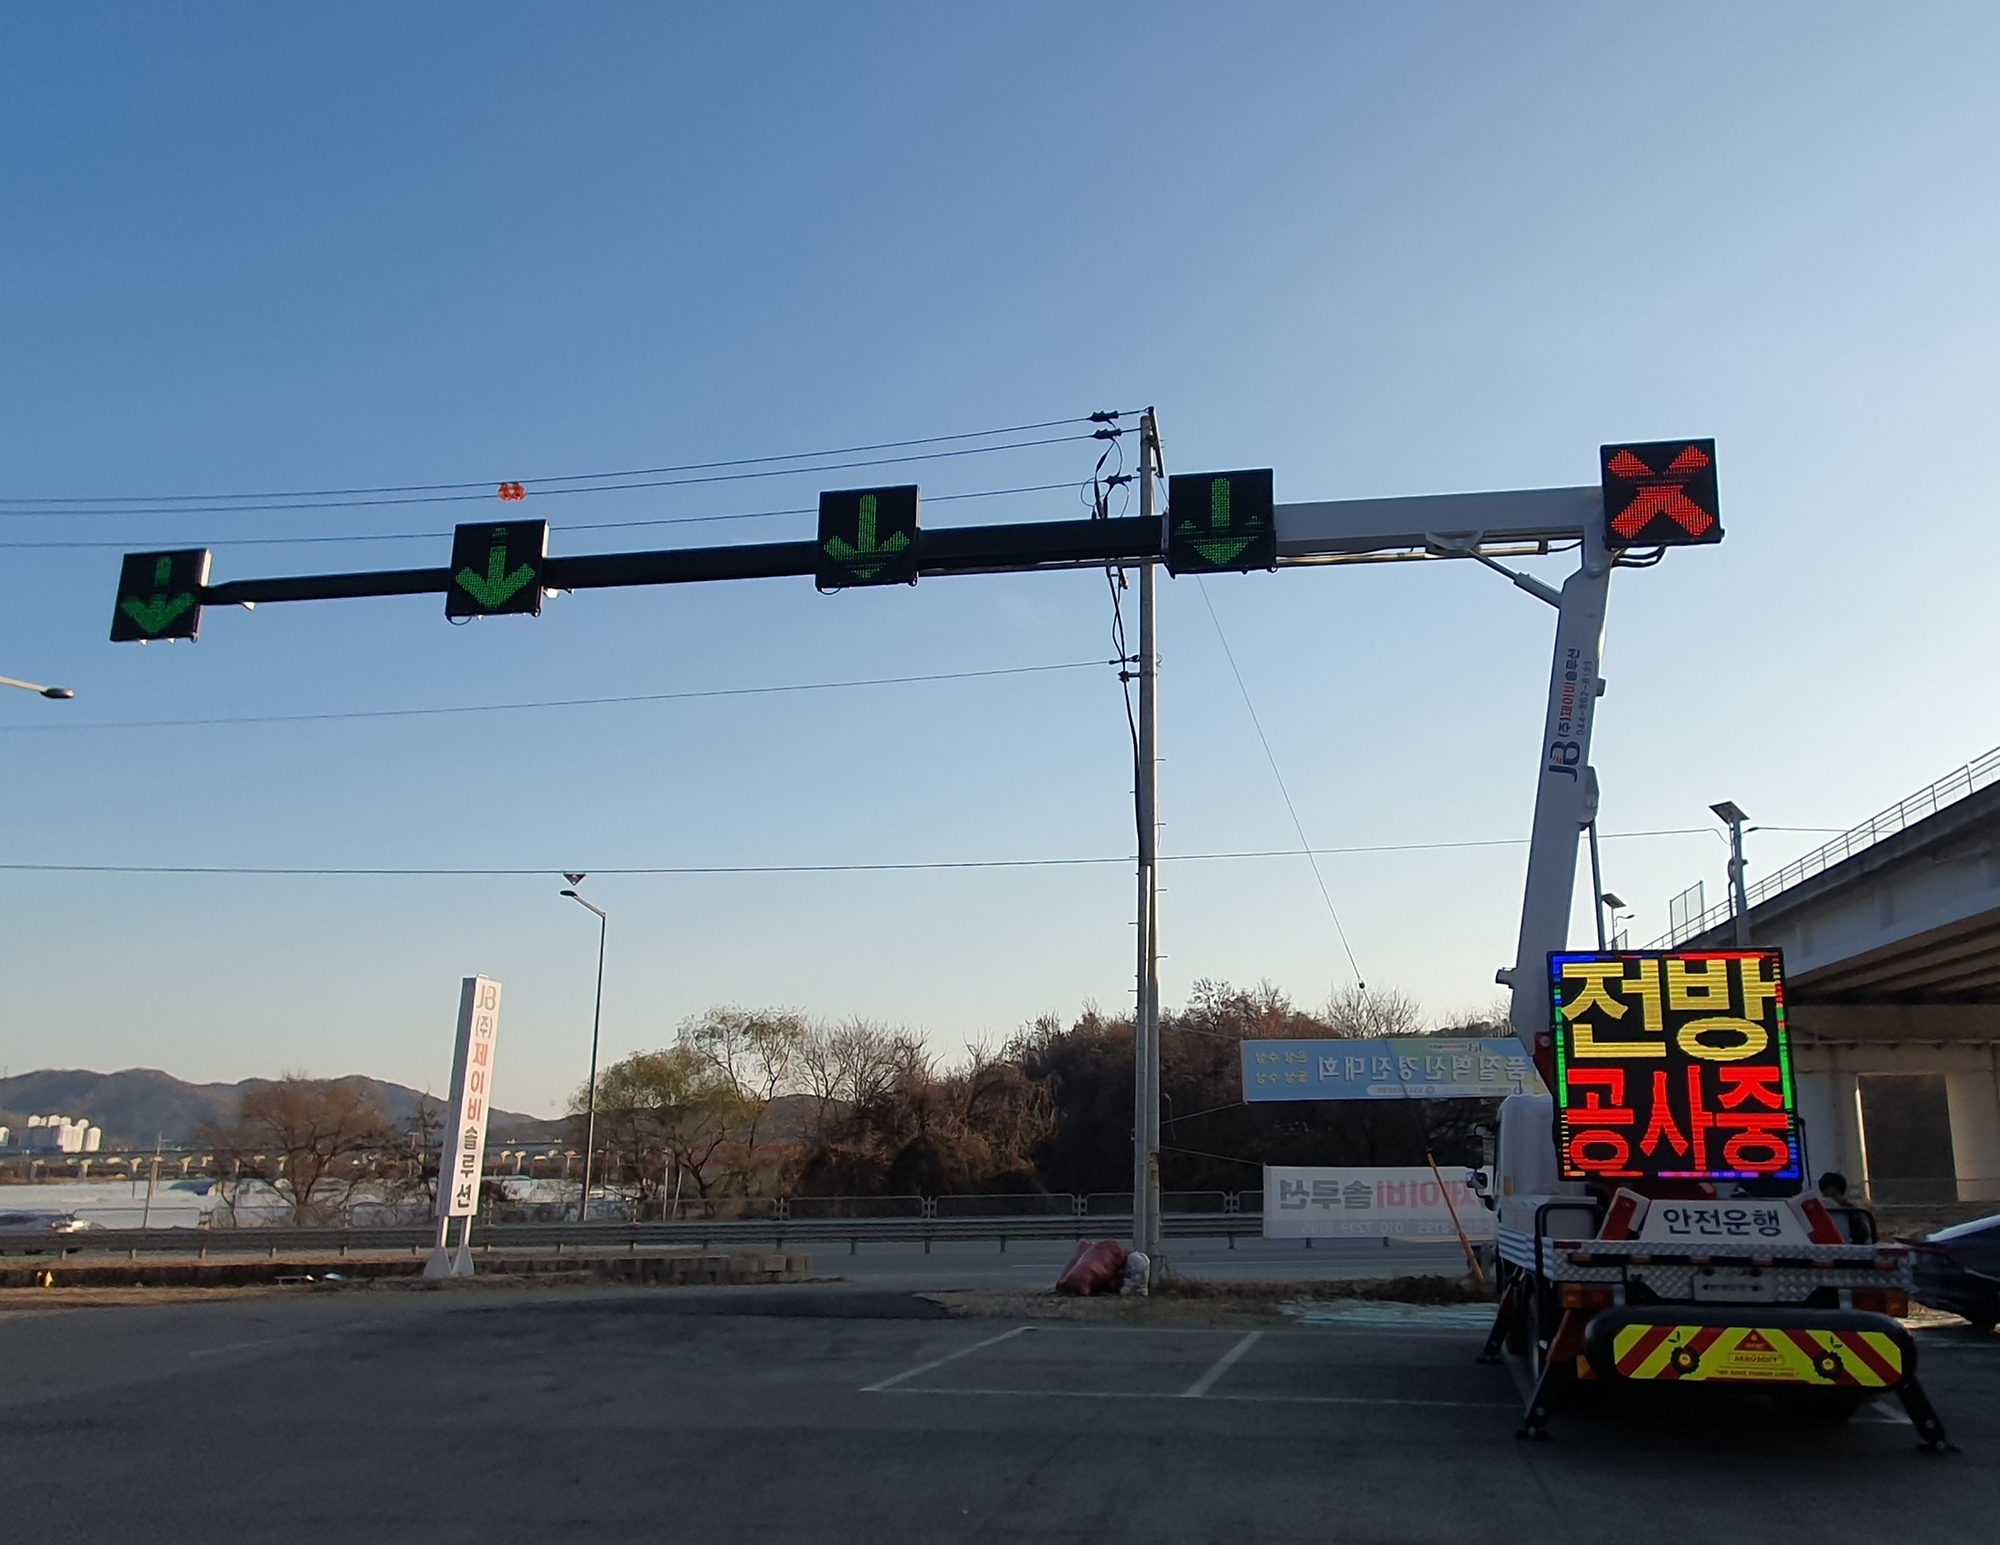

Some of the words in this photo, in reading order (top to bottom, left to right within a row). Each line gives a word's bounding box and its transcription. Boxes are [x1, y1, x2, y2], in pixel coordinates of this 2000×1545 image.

[1548, 740, 1581, 783] JB
[476, 984, 498, 1011] JB
[1560, 957, 1777, 1061] 전방
[1565, 1065, 1790, 1173] 공사중
[1662, 1208, 1782, 1238] 안전운행
